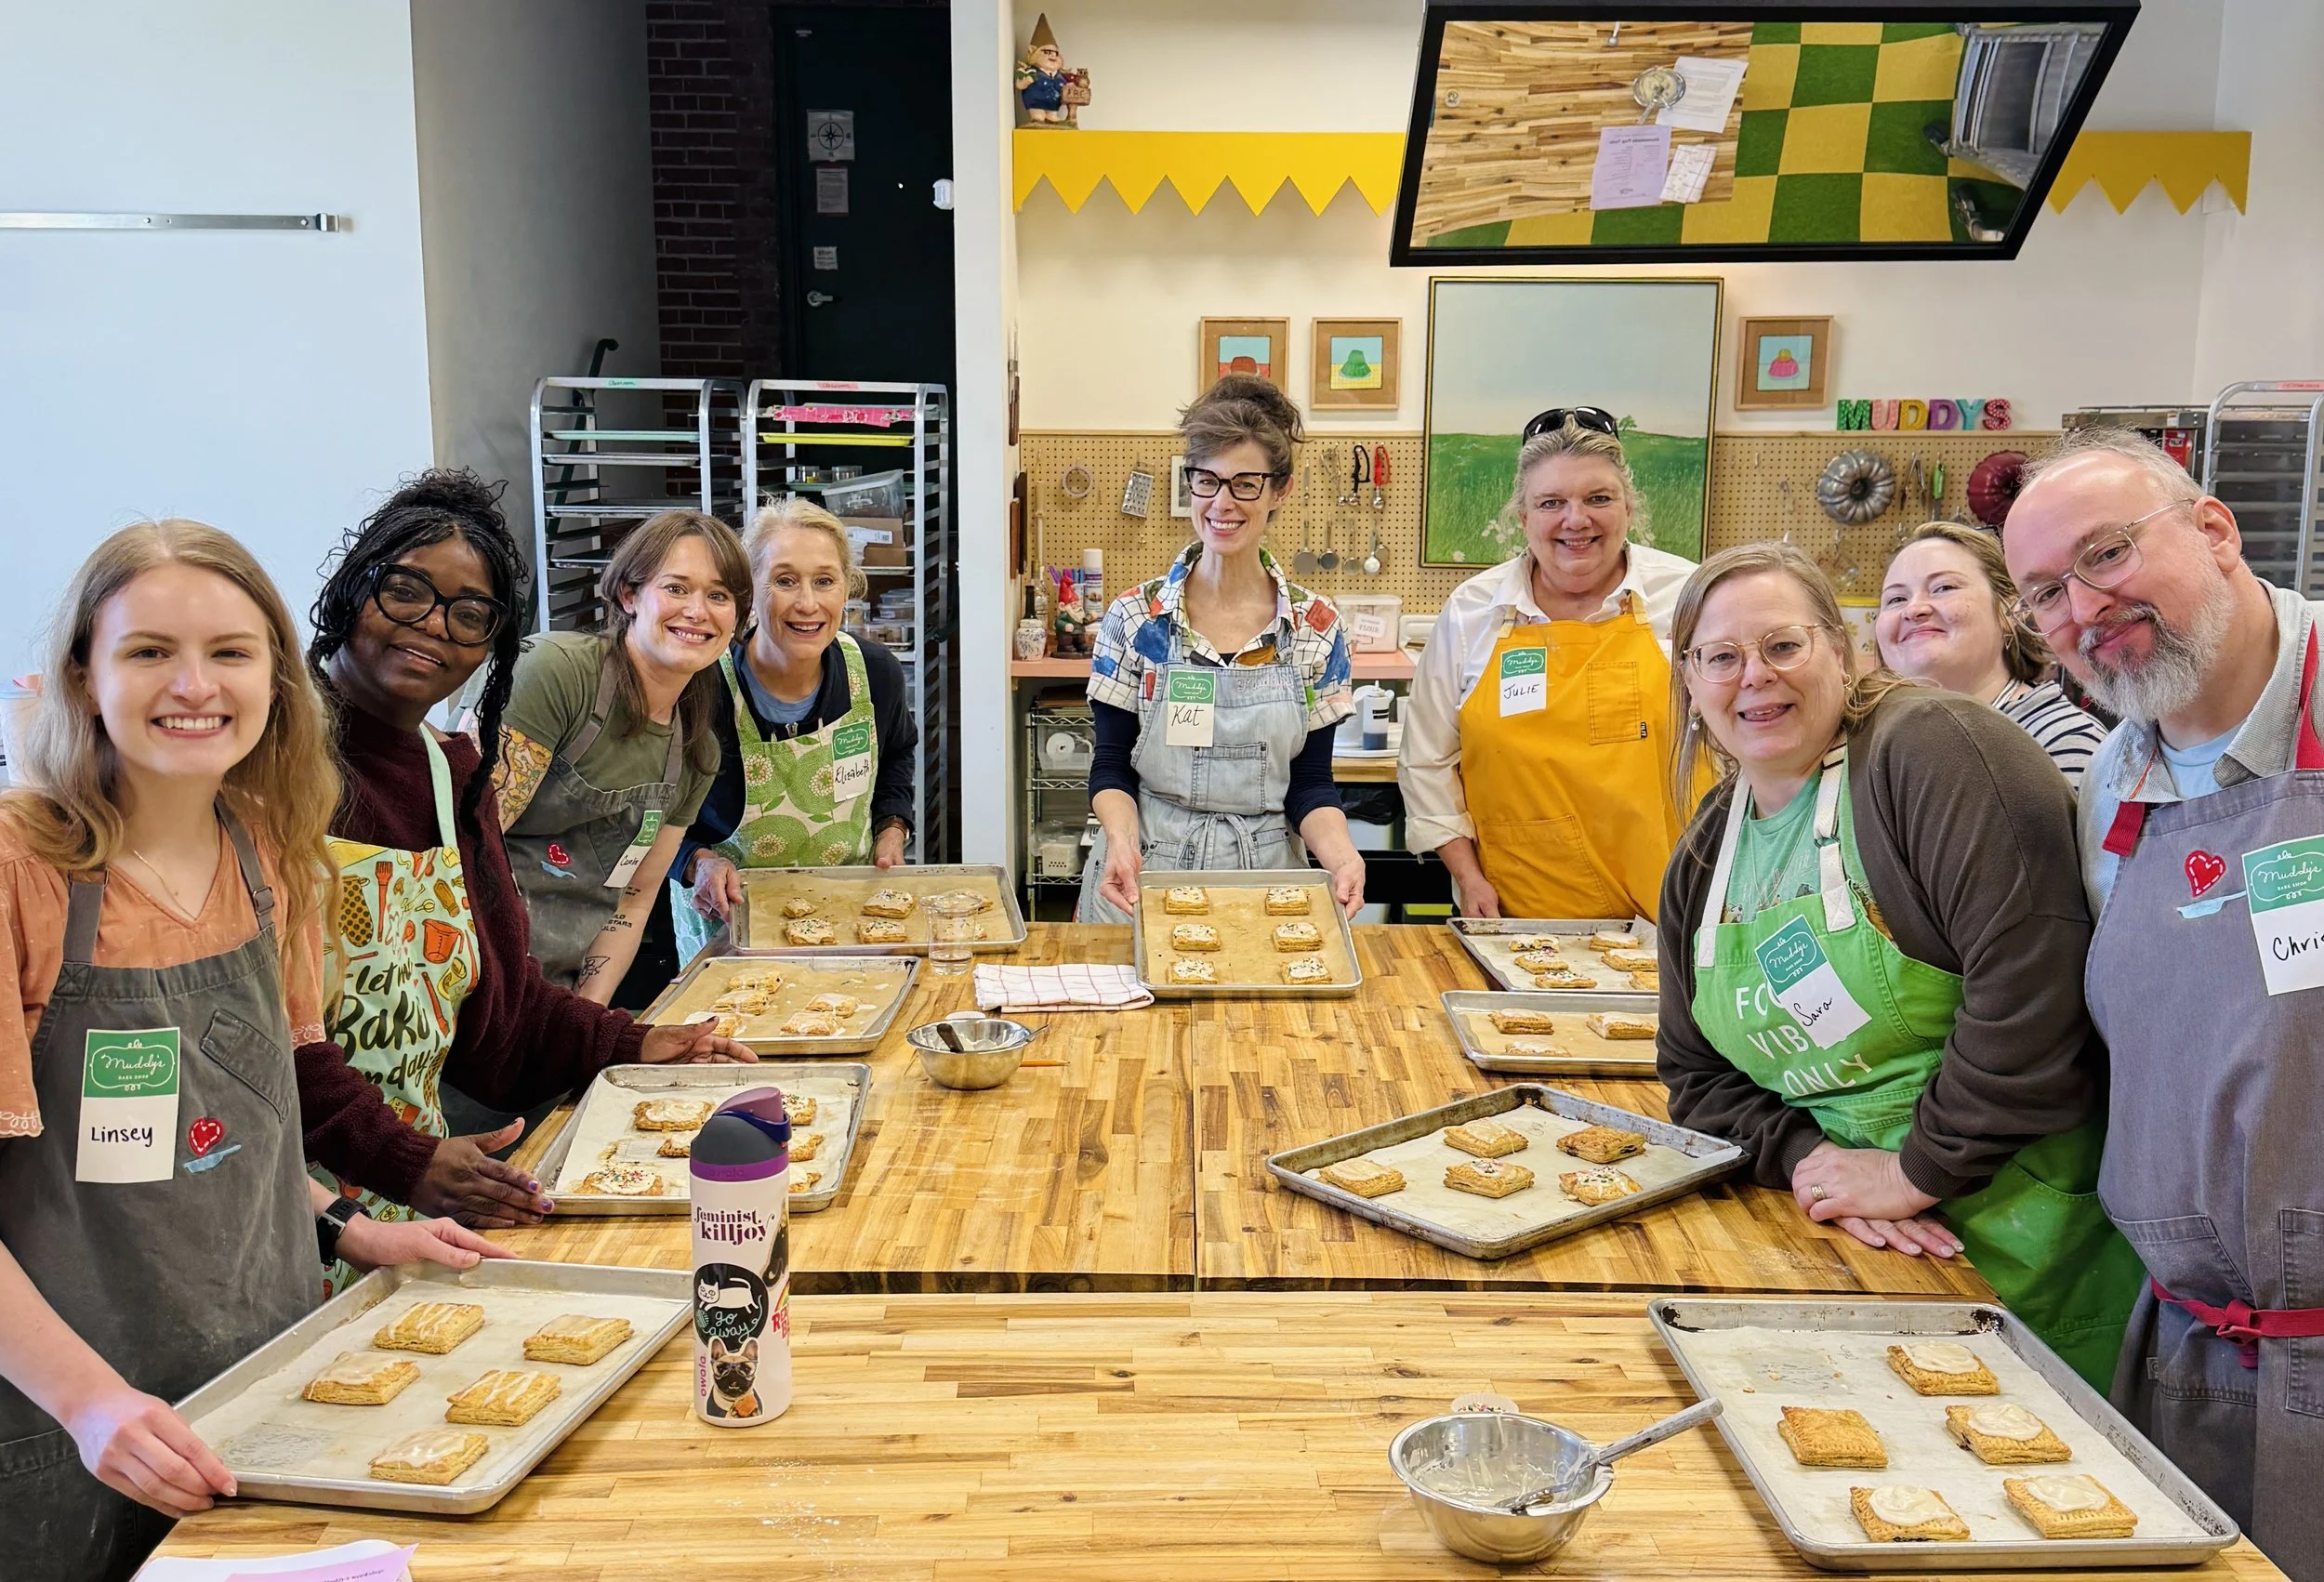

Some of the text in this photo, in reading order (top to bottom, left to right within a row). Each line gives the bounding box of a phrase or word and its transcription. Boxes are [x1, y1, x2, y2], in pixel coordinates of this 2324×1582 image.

[1836, 399, 2012, 430] MUDDYS
[1503, 683, 1540, 700] JULIE
[1171, 705, 1205, 727] Kat
[835, 758, 870, 784] Elizabeth
[2258, 861, 2322, 883] Muddy's
[1769, 939, 1808, 968] Muddy's
[356, 962, 398, 995] Let
[1736, 981, 1785, 1020] FO
[1793, 996, 1833, 1027] Sara
[1746, 1024, 1809, 1060] VIB
[100, 1053, 165, 1075] Muddy's
[1783, 1053, 1872, 1097] ONLY
[91, 1126, 153, 1148] Linsey
[701, 1213, 774, 1246] killjoy
[715, 1311, 737, 1327] go
[706, 1323, 749, 1344] away
